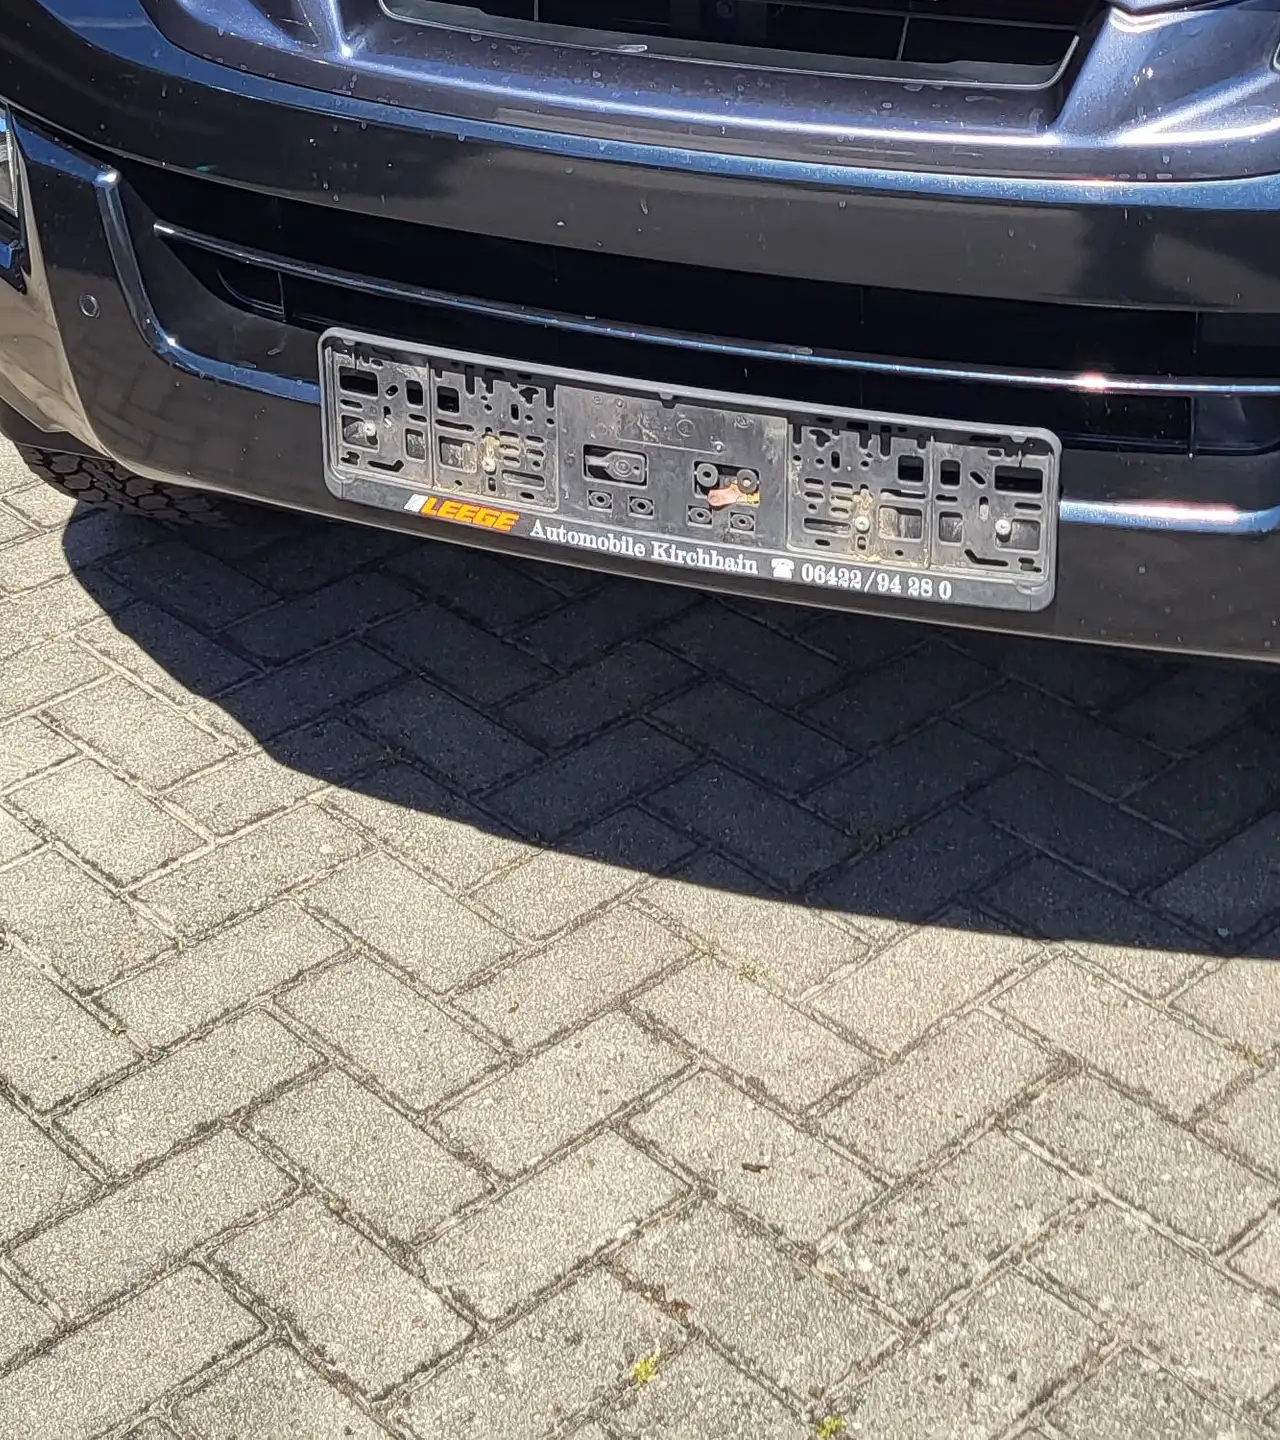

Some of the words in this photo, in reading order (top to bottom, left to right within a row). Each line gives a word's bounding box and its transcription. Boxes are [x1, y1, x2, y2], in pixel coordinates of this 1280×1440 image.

[420, 496, 520, 532] LEEGE
[530, 518, 646, 558] Automobile
[650, 540, 759, 577] Kirchhain
[908, 576, 933, 598] 28
[938, 580, 952, 600] 0
